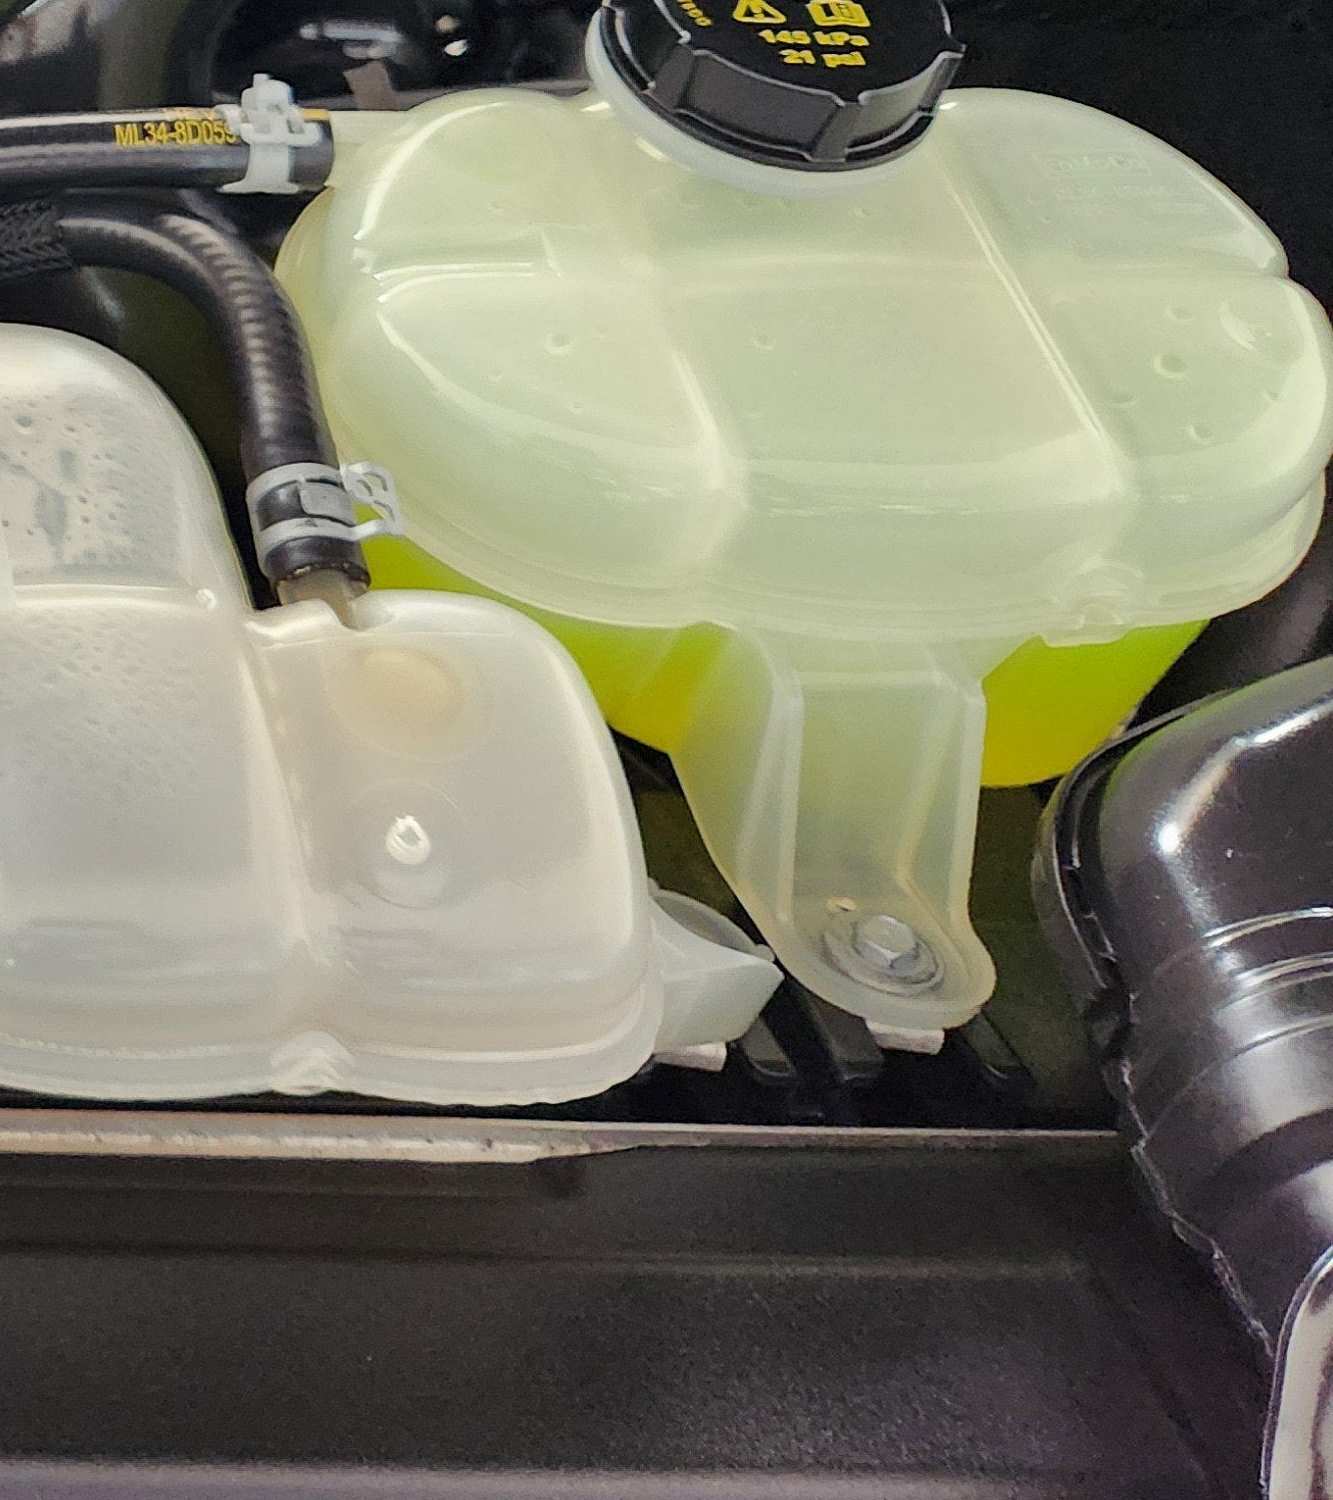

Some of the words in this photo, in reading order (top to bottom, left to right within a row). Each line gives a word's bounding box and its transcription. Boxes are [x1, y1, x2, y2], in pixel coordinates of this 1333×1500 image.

[758, 29, 811, 46] 145
[812, 30, 870, 47] kPa
[778, 48, 816, 65] 21
